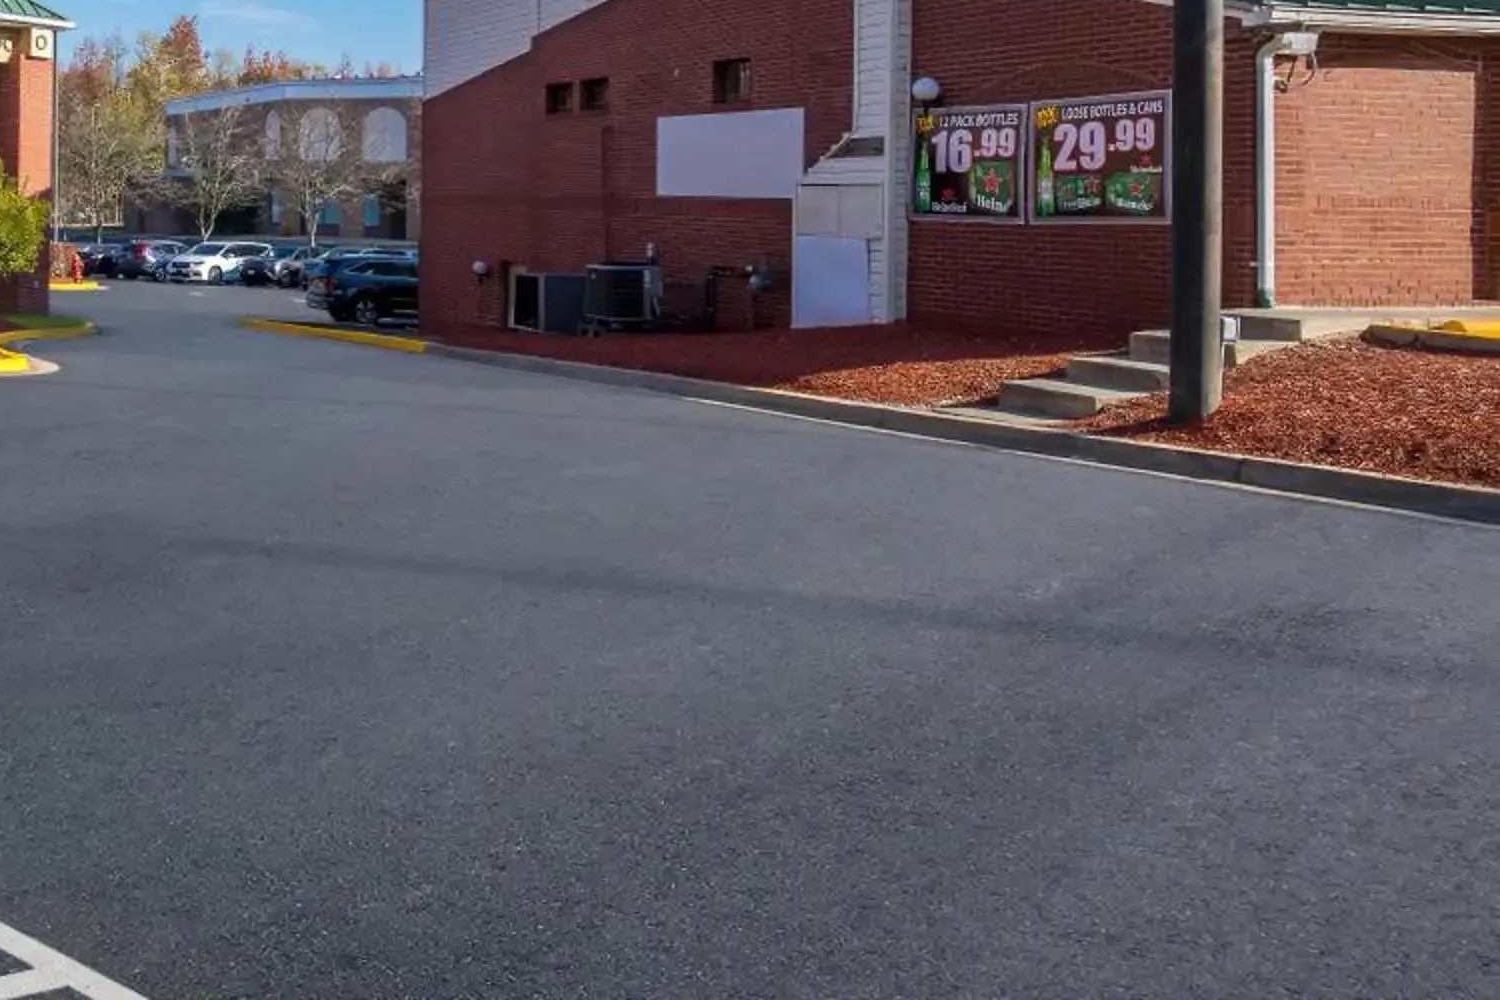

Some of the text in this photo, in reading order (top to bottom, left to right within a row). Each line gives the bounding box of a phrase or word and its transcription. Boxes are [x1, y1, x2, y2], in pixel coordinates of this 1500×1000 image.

[1061, 105, 1089, 120] LOOSE
[1090, 103, 1128, 119] BOTTLES
[1137, 100, 1163, 115] CANS
[950, 114, 975, 128] PACK
[975, 113, 1019, 127] BOTTLES
